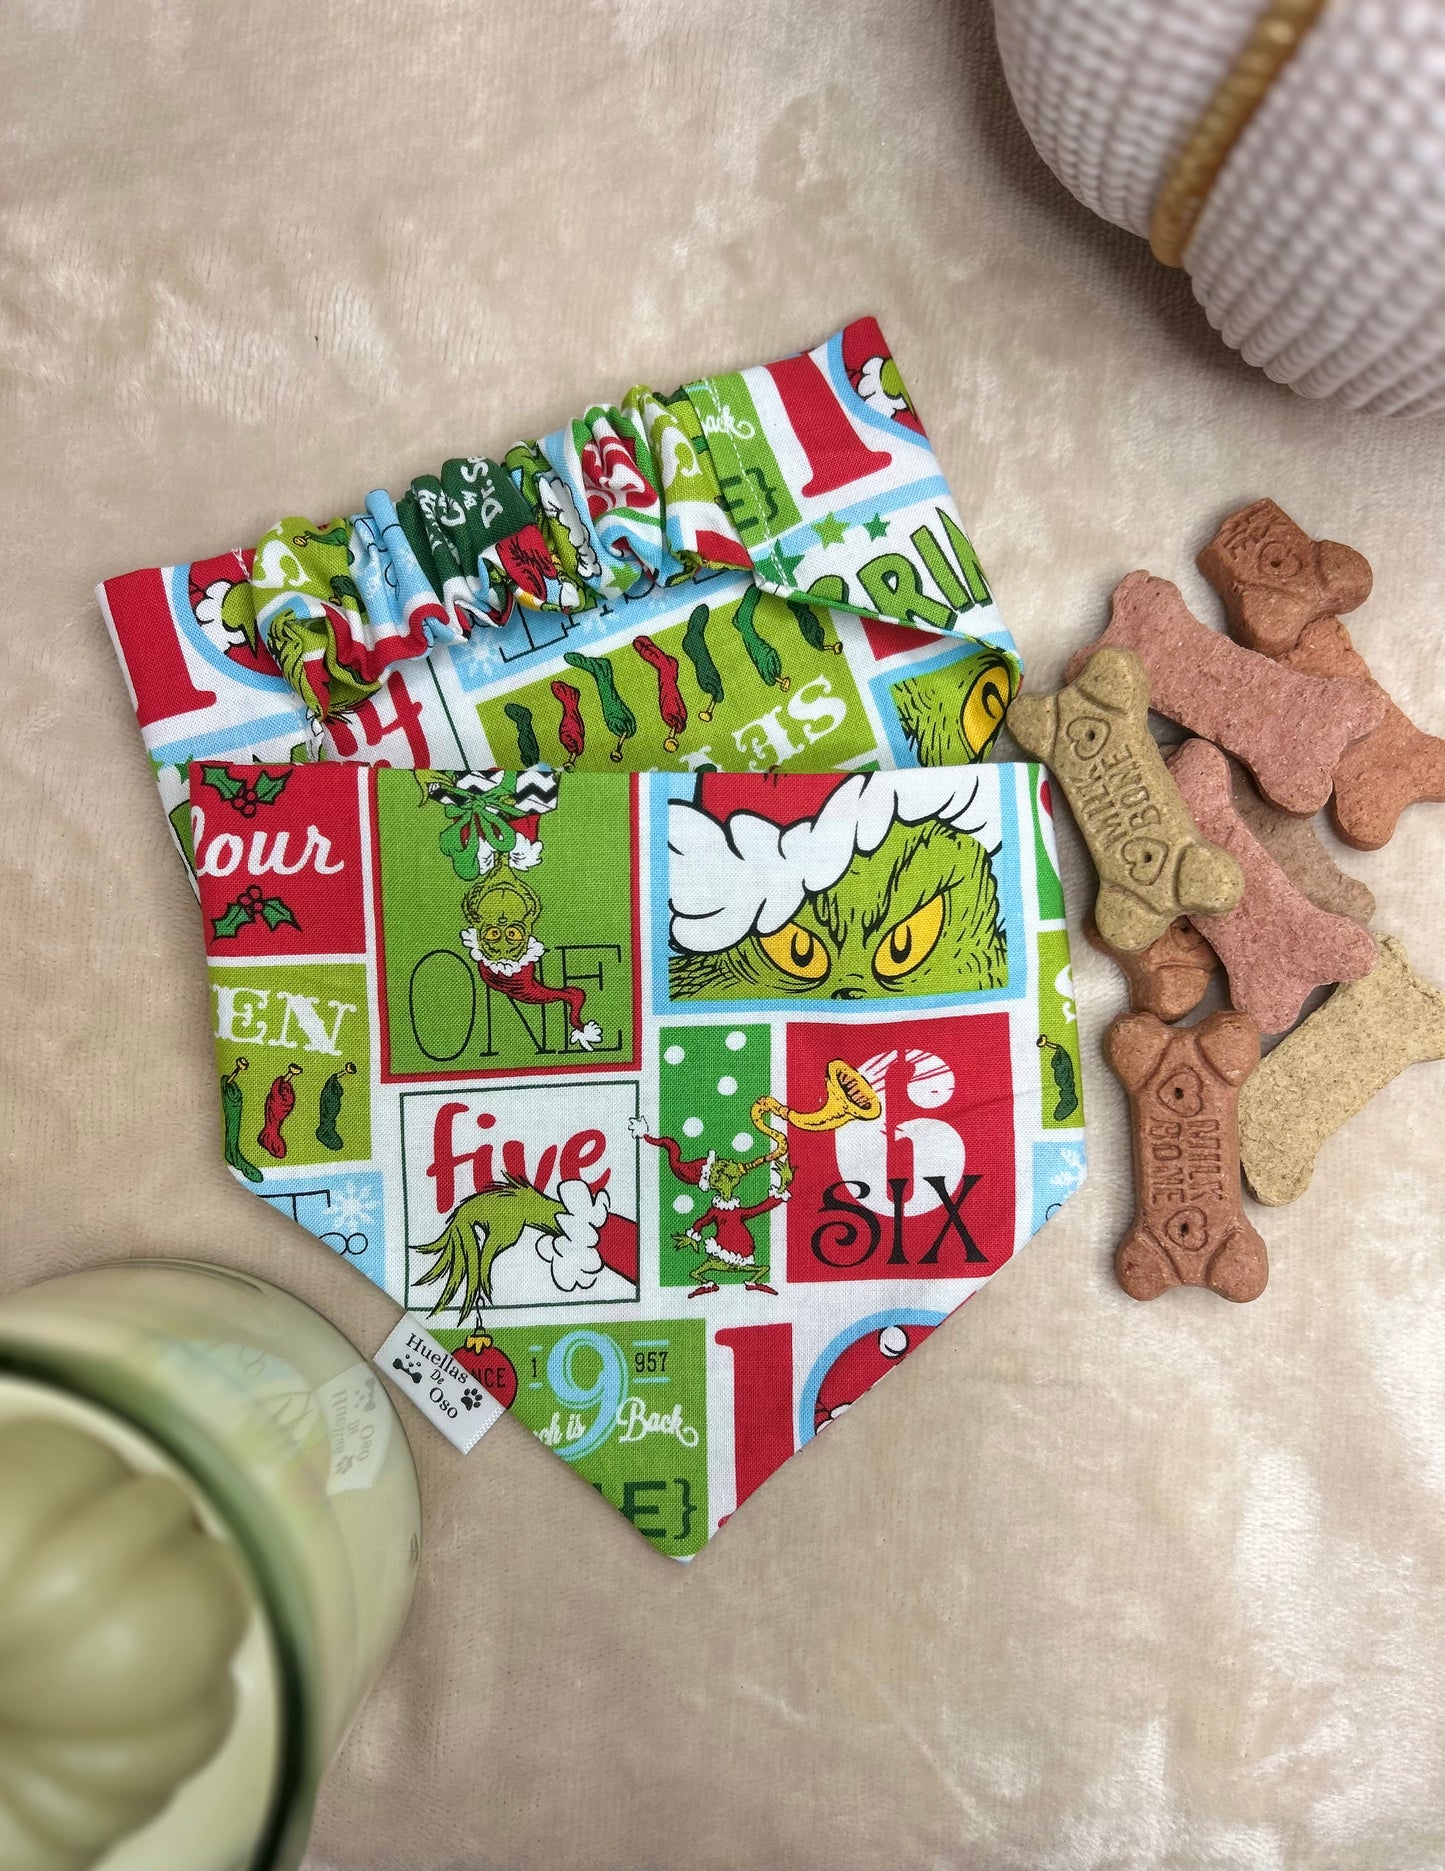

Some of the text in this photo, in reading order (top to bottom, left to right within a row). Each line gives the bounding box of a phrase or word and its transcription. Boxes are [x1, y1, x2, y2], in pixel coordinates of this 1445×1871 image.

[700, 404, 756, 440] ack
[1068, 763, 1128, 852] MILK
[1101, 743, 1162, 832] BONE
[408, 944, 624, 1063] ONE
[426, 1101, 612, 1214] five
[835, 1048, 967, 1218] 6
[1149, 1116, 1185, 1204] BONE
[1186, 1118, 1224, 1201] MILK
[811, 1174, 990, 1269] SIX
[405, 1332, 469, 1384] Huellas
[429, 1368, 446, 1385] De
[546, 1329, 630, 1463] 9
[634, 1350, 669, 1374] 957
[429, 1386, 459, 1419] Oso
[615, 1396, 700, 1449] Back
